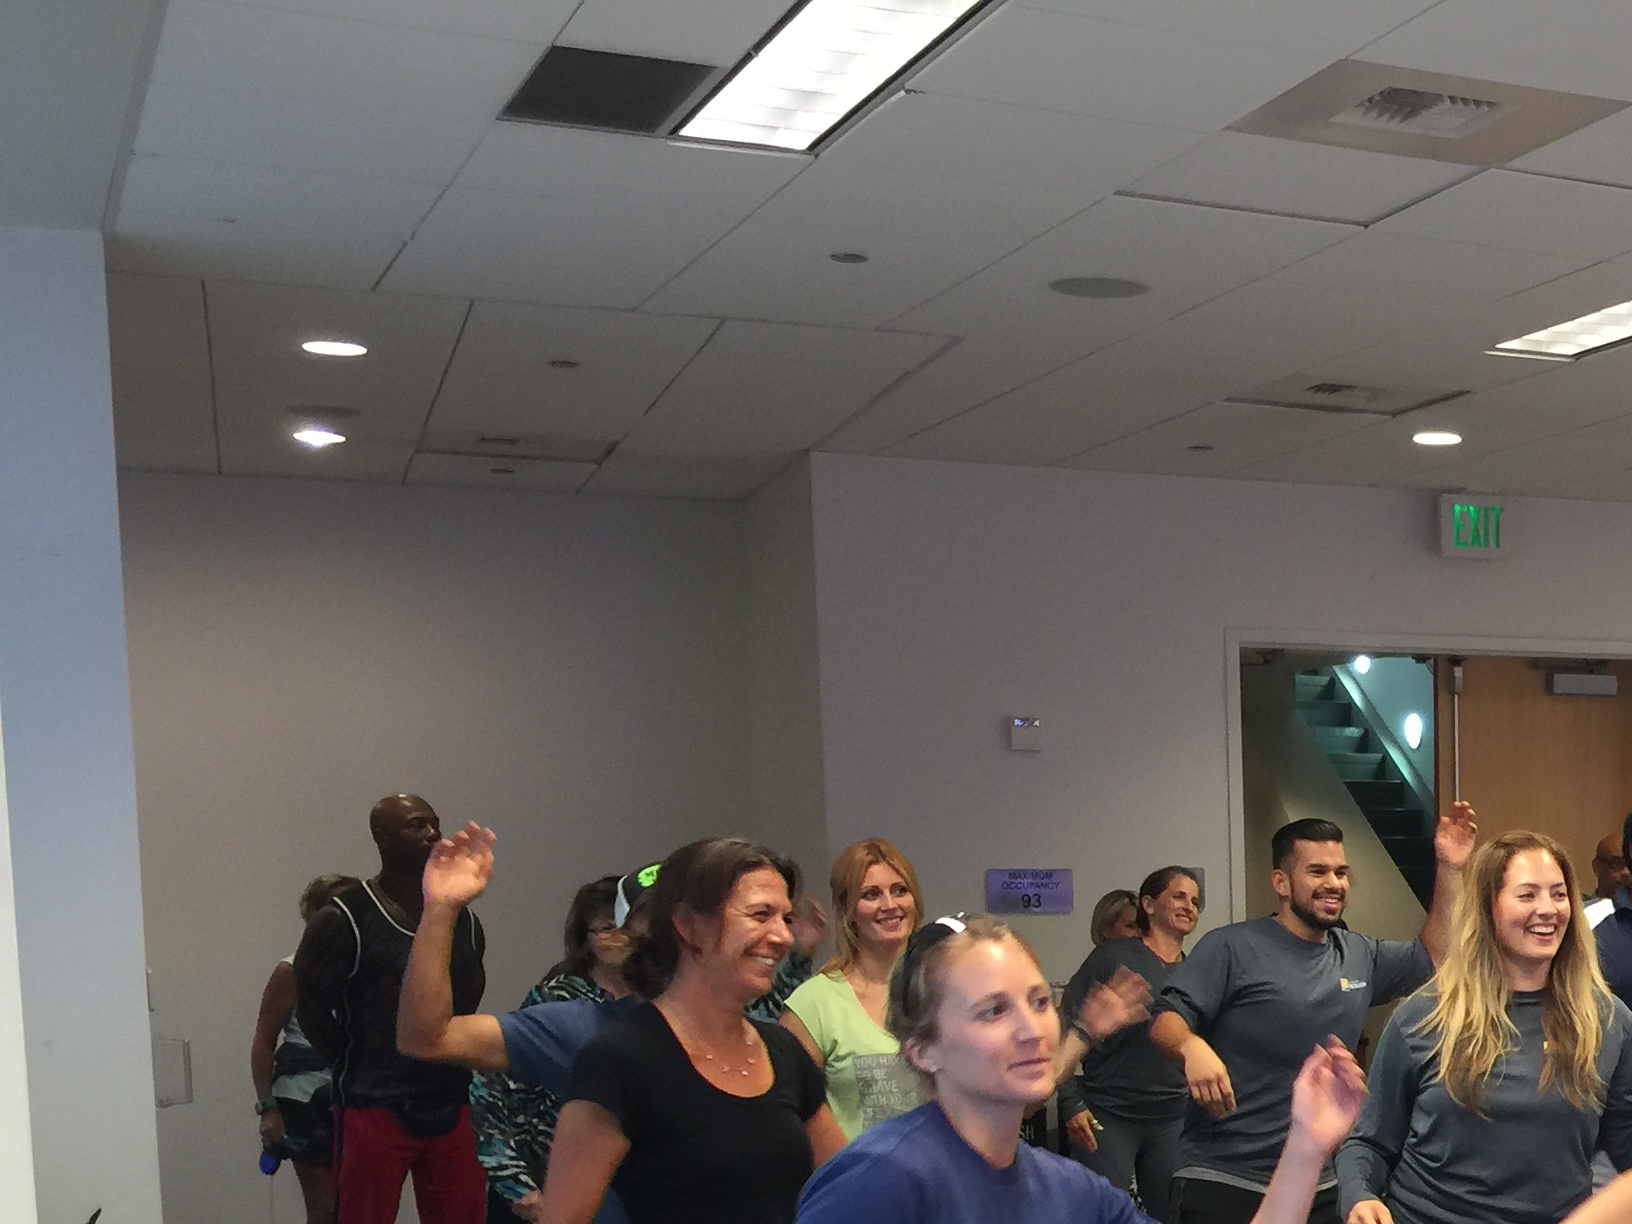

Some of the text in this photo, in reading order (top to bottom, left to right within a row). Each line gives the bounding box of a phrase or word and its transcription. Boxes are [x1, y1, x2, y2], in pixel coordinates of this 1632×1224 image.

[1453, 503, 1504, 548] EXIT
[1008, 872, 1053, 880] MAXIMUM
[1001, 881, 1060, 890] OCCUPANCY
[1021, 893, 1042, 908] 93
[854, 1056, 877, 1068] YOU
[873, 1068, 888, 1080] BE
